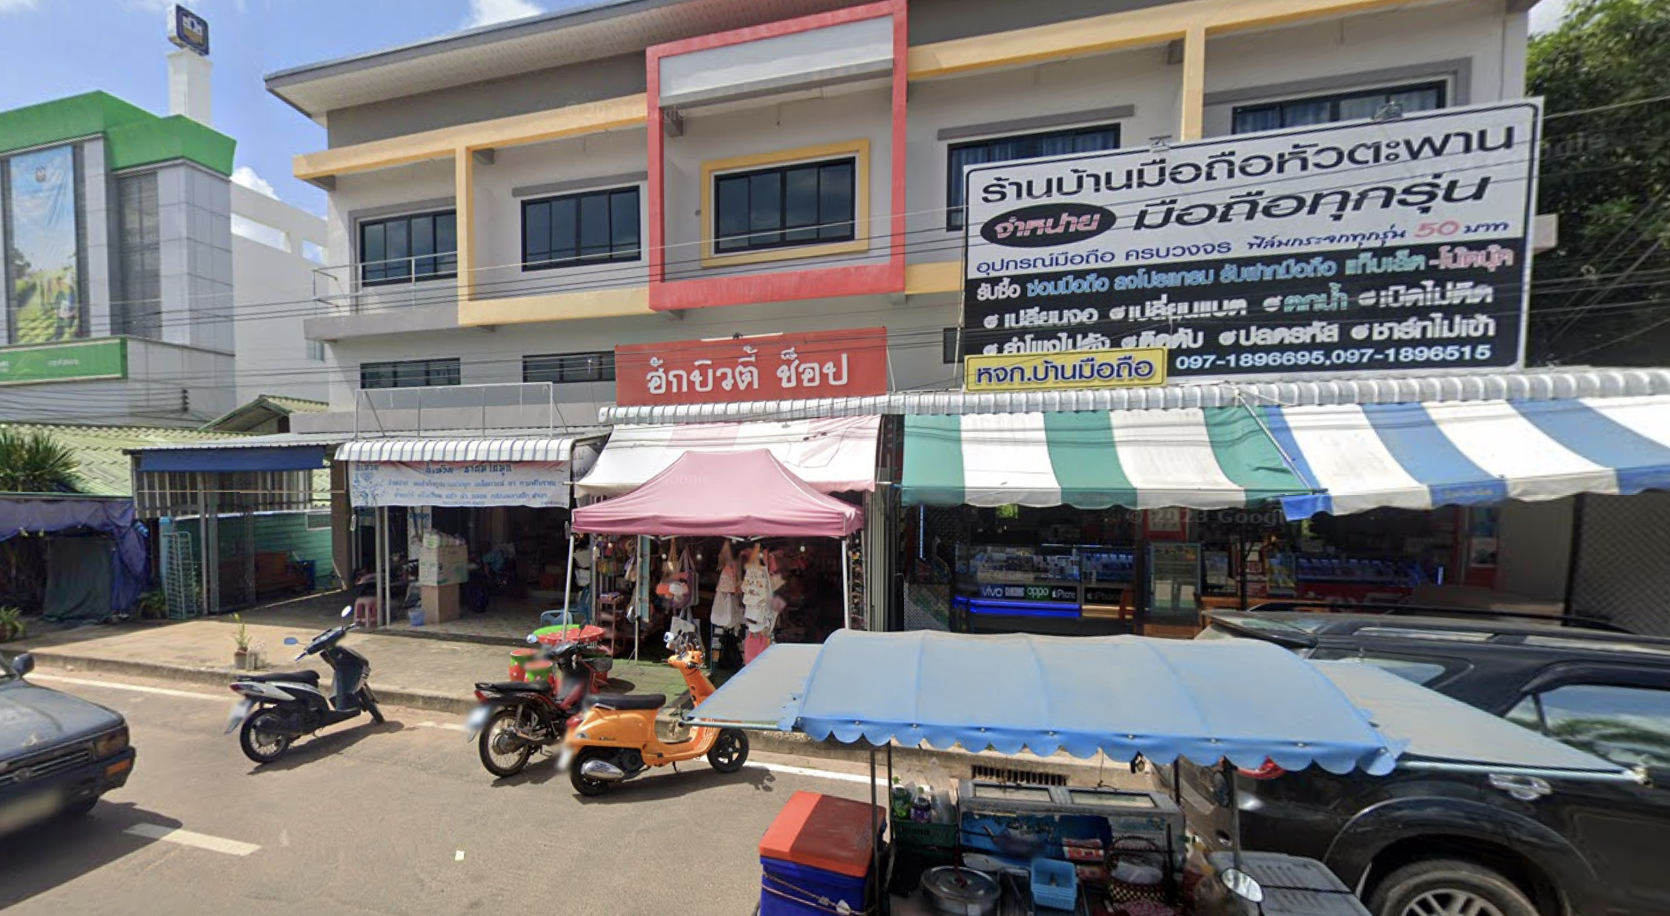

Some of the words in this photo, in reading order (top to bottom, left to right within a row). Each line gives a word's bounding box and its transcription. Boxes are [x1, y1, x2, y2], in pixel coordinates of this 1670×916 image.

[981, 124, 1515, 204] ร้านบ้านมือถือหัวตะพาน
[994, 212, 1101, 239] จำหน่าย
[1133, 173, 1492, 231] มือถือทุกรุ่น
[976, 248, 1115, 276] อุปกรณ์มือถือ
[1125, 240, 1232, 262] ครบวงจร
[1414, 220, 1461, 239] 50
[1463, 221, 1511, 235] บาท
[646, 344, 759, 395] ฮักบิวตี้
[976, 355, 1154, 384] หจก.บ้านมือถือ
[981, 585, 1003, 597] vivo
